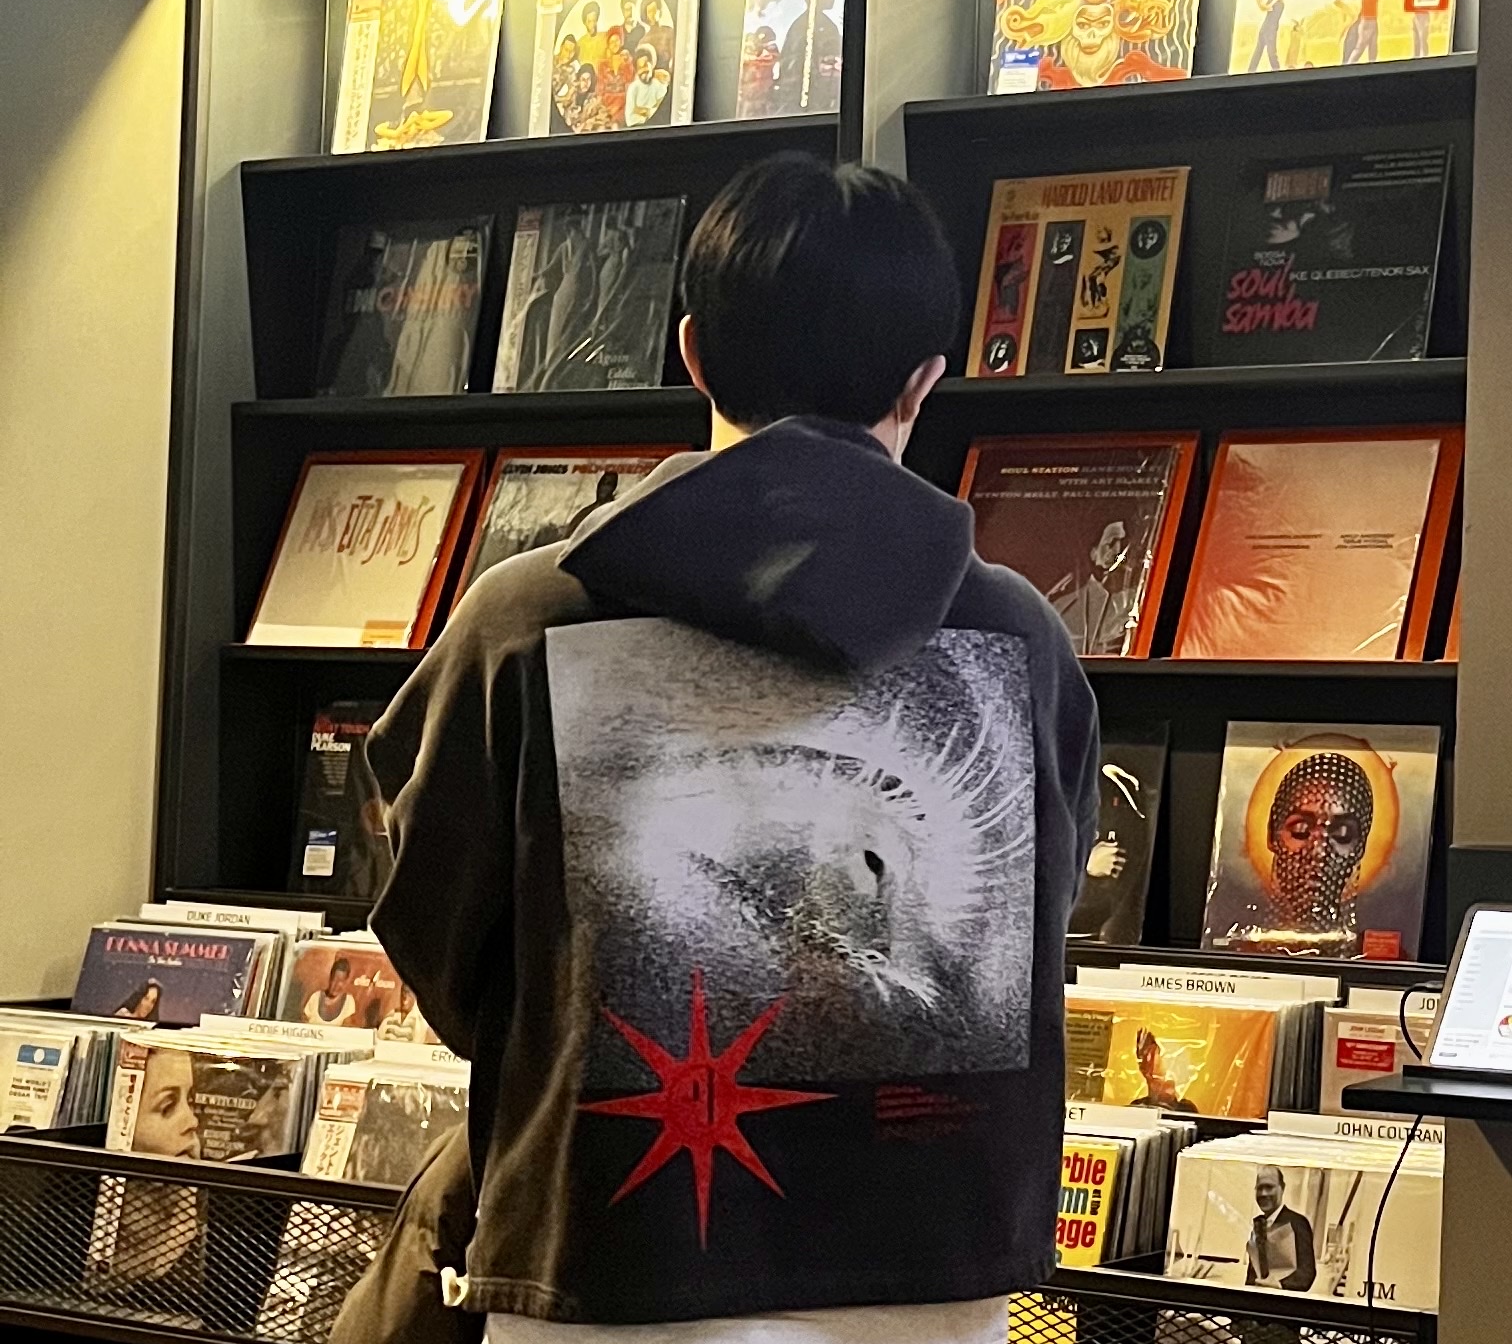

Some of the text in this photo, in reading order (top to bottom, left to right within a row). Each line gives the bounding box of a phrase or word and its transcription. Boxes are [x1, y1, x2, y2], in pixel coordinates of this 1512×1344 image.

[1140, 975, 1237, 995] JAMES BROWN
[281, 1025, 325, 1040] HIGGINS
[1334, 1121, 1373, 1139] JOHN
